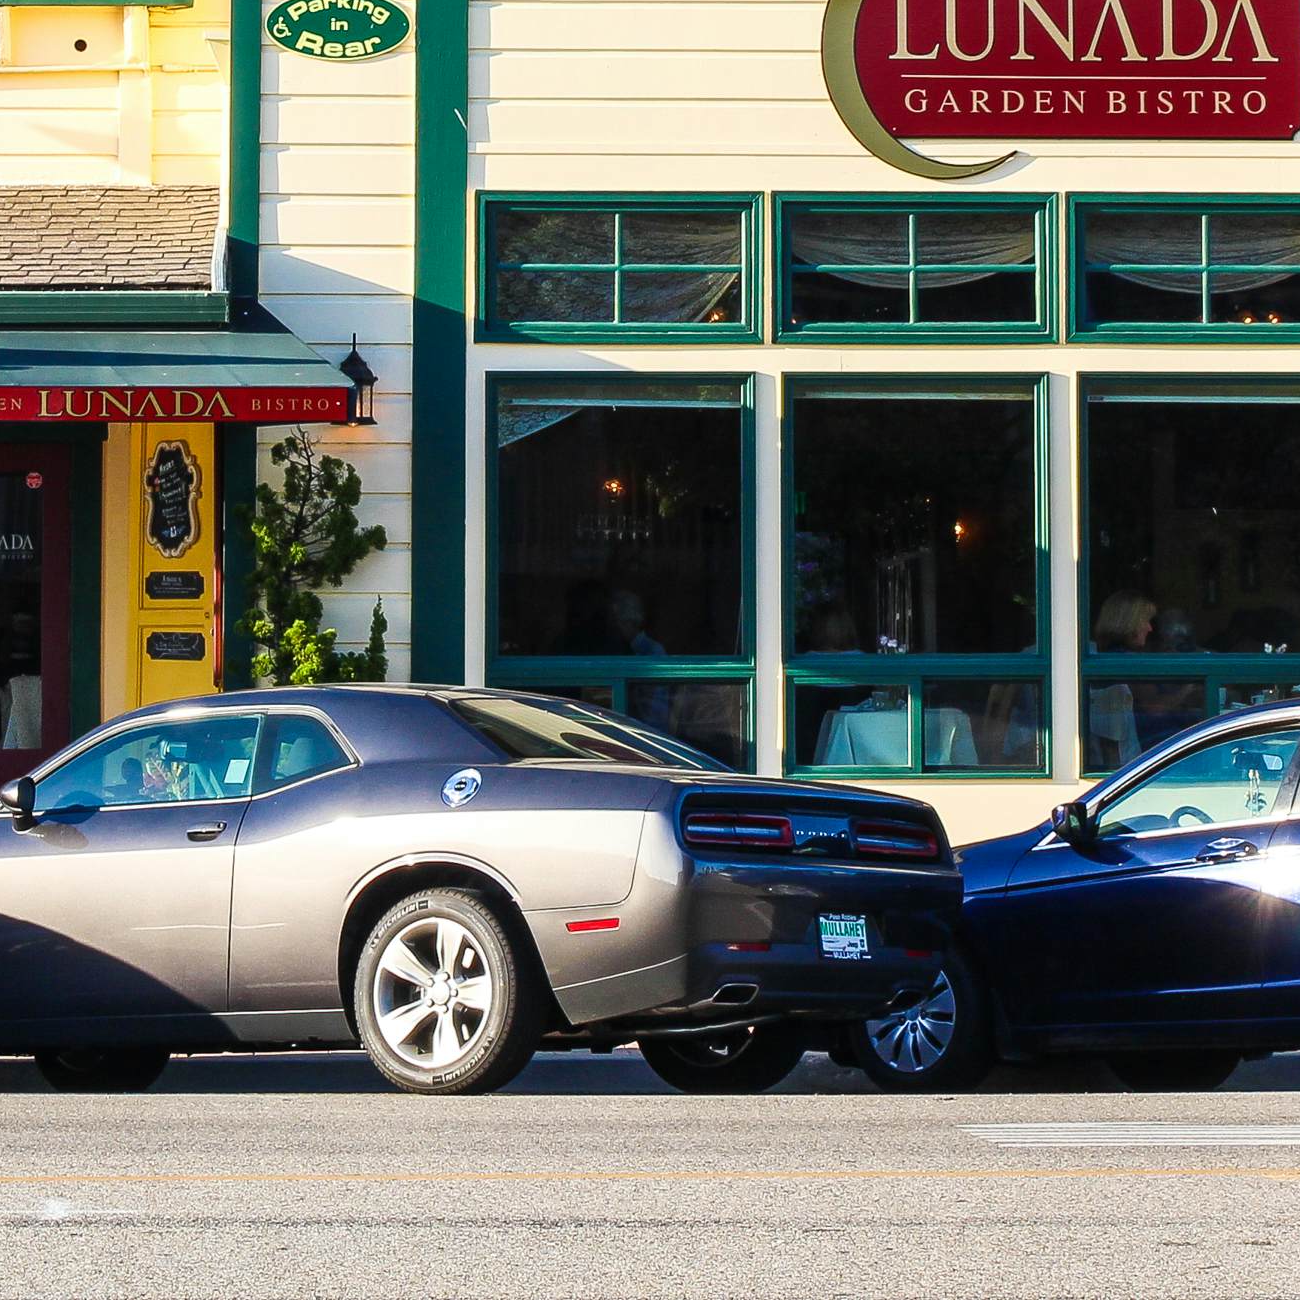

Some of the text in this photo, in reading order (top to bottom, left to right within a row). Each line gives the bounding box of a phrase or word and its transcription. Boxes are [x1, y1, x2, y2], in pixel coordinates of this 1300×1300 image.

[330, 18, 349, 31] in
[295, 30, 381, 57] Rear
[904, 90, 1268, 116] GARDEN BISTRO
[37, 390, 236, 418] LUNADA
[251, 399, 330, 411] BISTRO
[377, 903, 418, 938] MICHELIN
[820, 921, 866, 938] MULLAHEY
[445, 1047, 486, 1082] MICHELIN
